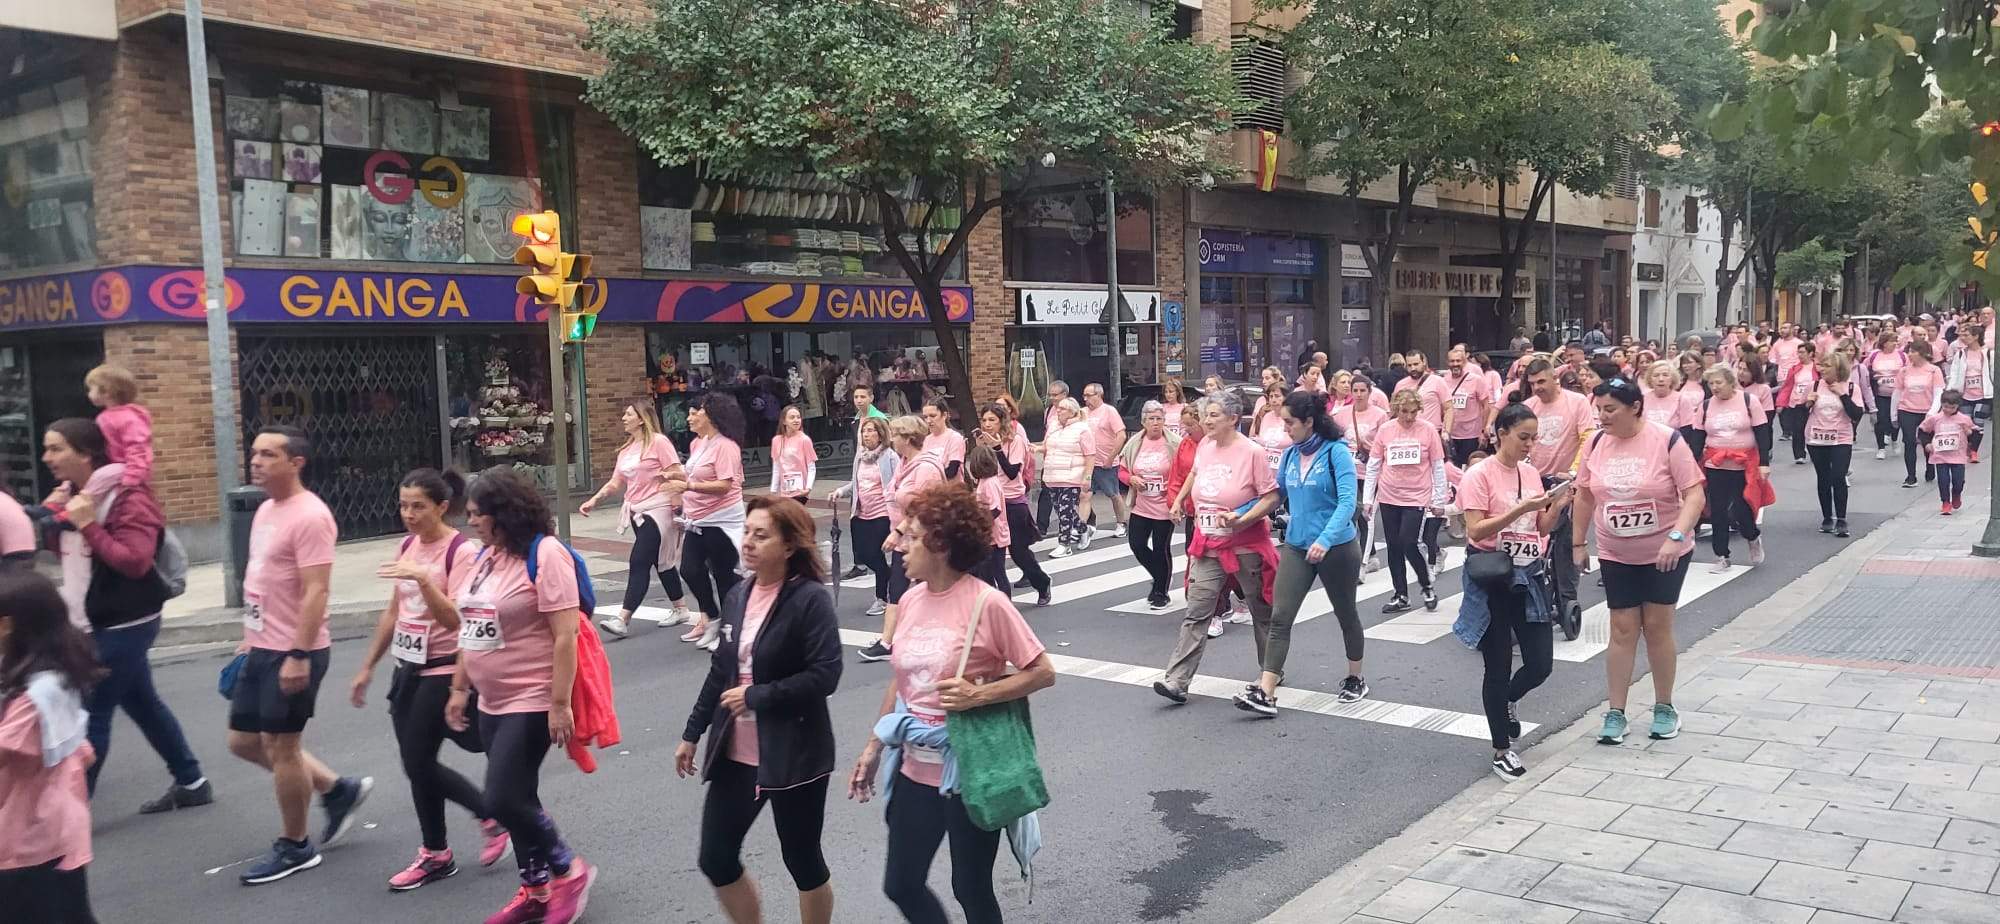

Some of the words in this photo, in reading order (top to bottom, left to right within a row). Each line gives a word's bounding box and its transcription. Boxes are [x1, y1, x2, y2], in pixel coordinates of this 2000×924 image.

[1212, 254, 1226, 262] CRM
[1444, 272, 1477, 292] VALLE
[1479, 274, 1493, 293] DE
[0, 279, 78, 326] GANGA
[279, 275, 471, 319] GANGA
[826, 288, 926, 319] GANGA
[1062, 298, 1089, 316] Petit
[1812, 432, 1837, 441] 3186
[1938, 438, 1956, 446] 862
[1391, 450, 1419, 460] 2886
[1609, 511, 1655, 529] 1272
[1502, 541, 1540, 558] 3748
